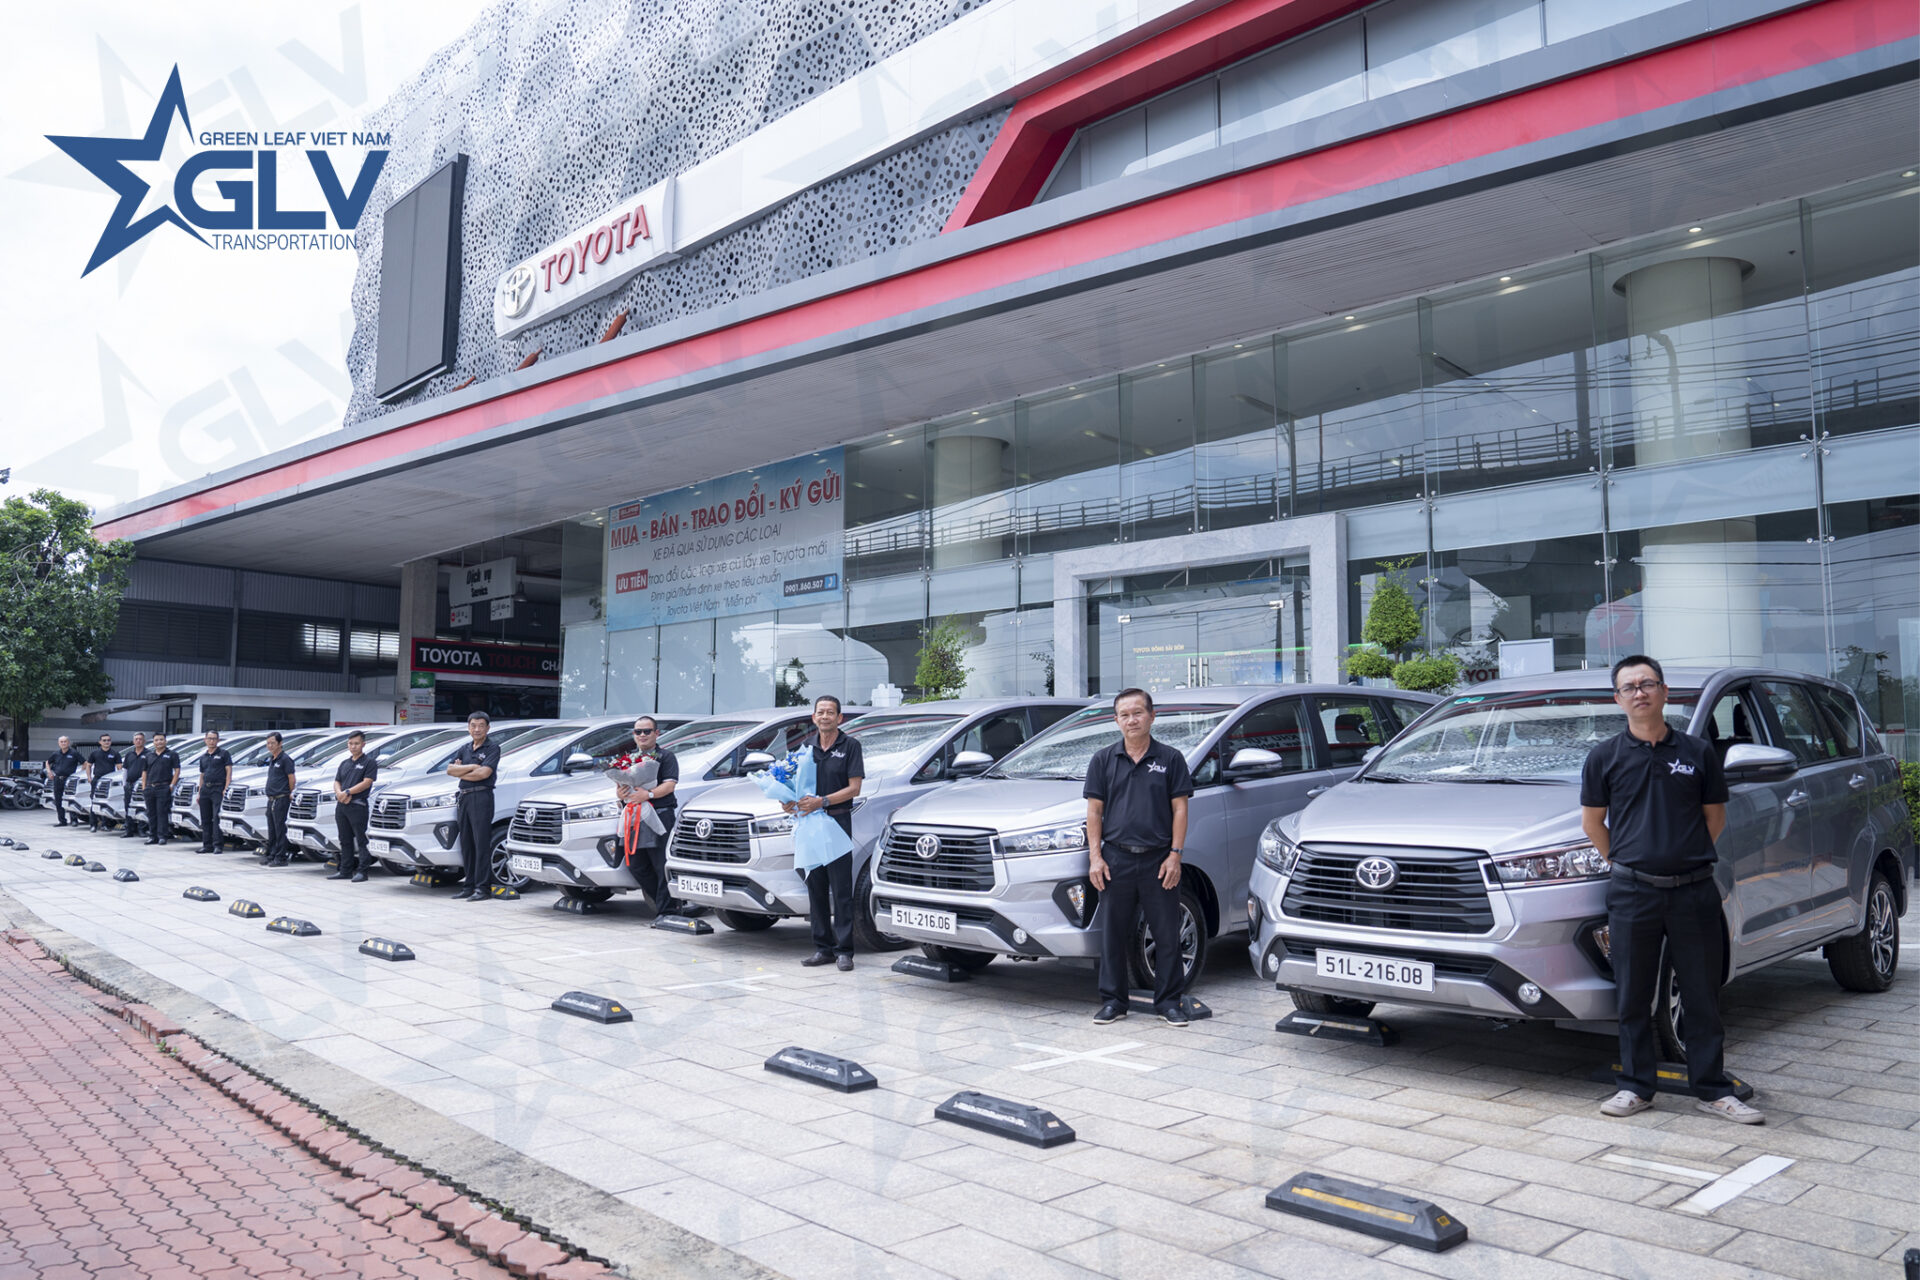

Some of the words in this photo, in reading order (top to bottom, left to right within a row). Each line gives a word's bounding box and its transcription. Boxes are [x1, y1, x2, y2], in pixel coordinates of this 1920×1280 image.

[541, 204, 651, 292] TOYOTA
[611, 524, 640, 550] MUA
[650, 511, 680, 541] BÁN
[691, 503, 731, 532] TRAO
[734, 482, 766, 523] ĐỔI
[780, 477, 803, 513] KÝ
[807, 468, 841, 505] GỬI
[652, 547, 662, 560] XE
[677, 540, 695, 556] QUA
[736, 526, 758, 545] CÁC
[630, 572, 647, 589] TIÊN
[760, 553, 771, 565] xe
[773, 546, 806, 565] Toyota
[419, 647, 483, 667] TOYOTA
[488, 653, 537, 670] TOUCH
[681, 879, 719, 895] 51L-419.18
[896, 910, 951, 930] 51L-216.06
[1325, 956, 1423, 985] 51L-216.08
